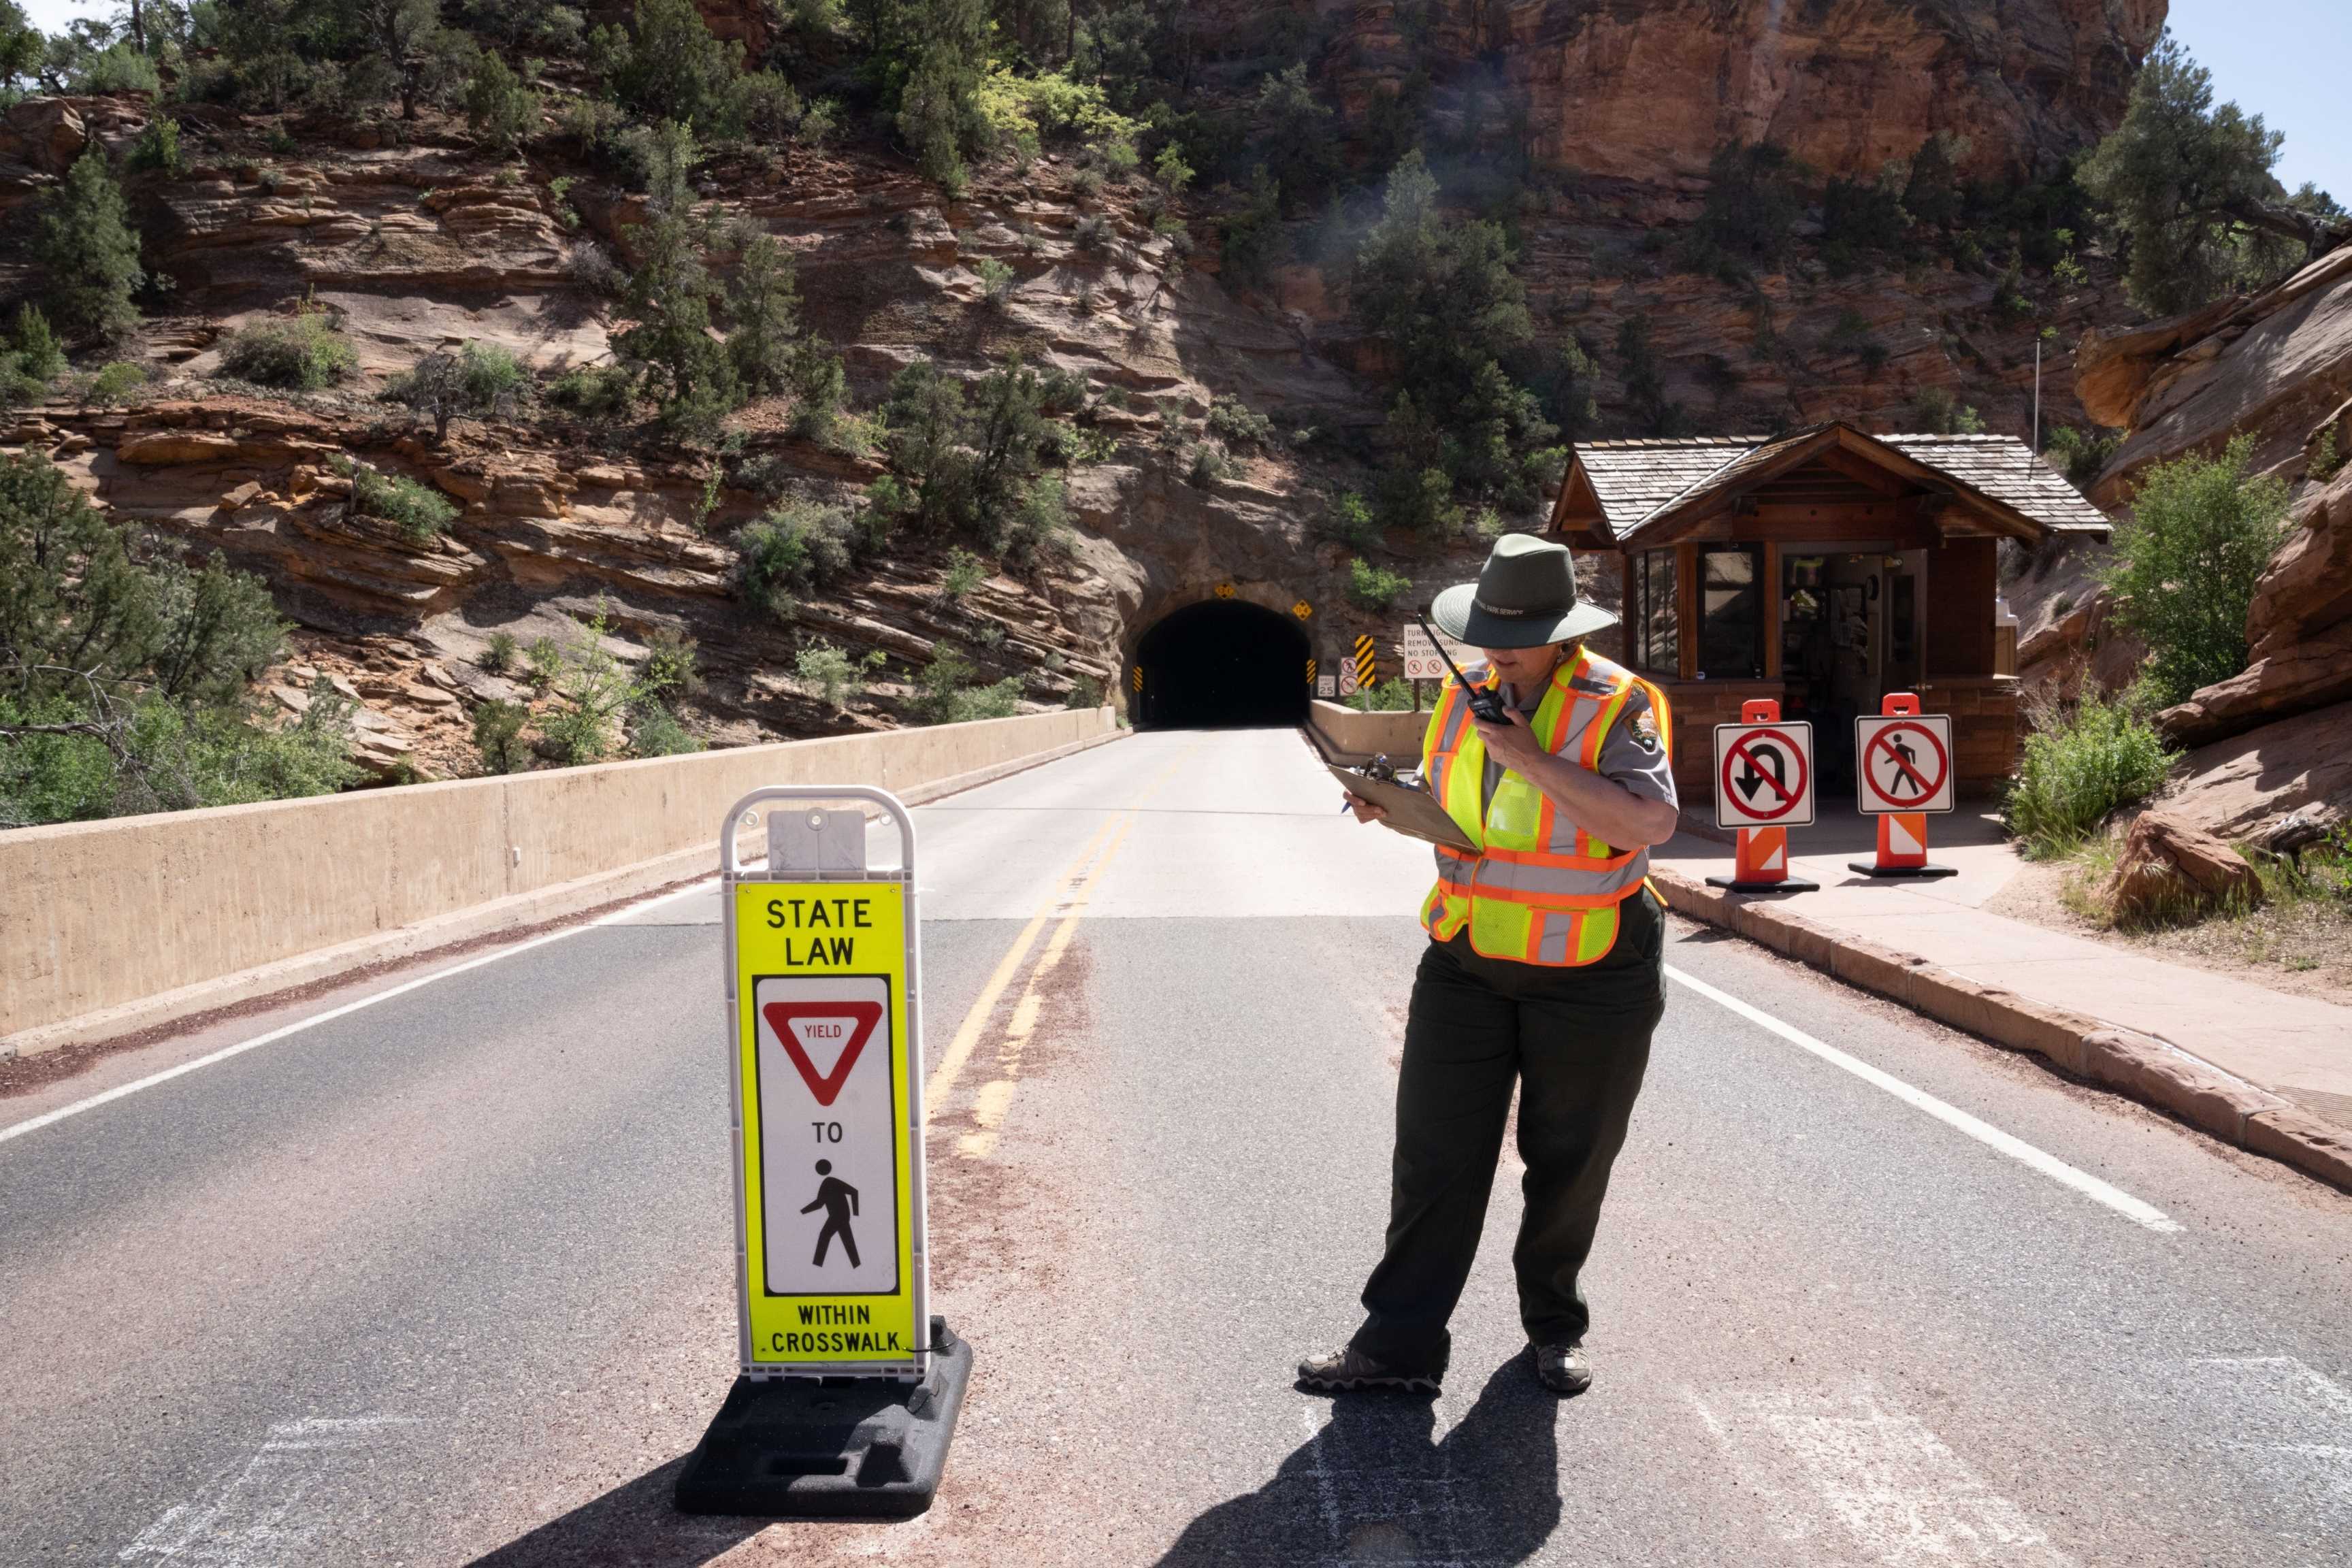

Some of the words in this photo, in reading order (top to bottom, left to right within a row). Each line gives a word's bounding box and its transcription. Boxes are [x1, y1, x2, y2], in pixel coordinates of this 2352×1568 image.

[1320, 686, 1334, 695] 25
[766, 899, 872, 929] STATE
[785, 937, 854, 966] LAW
[804, 1024, 842, 1038] YIELD
[811, 1122, 843, 1143] TO
[798, 1305, 870, 1326] WITHIN
[772, 1332, 900, 1353] CROSSWALK
